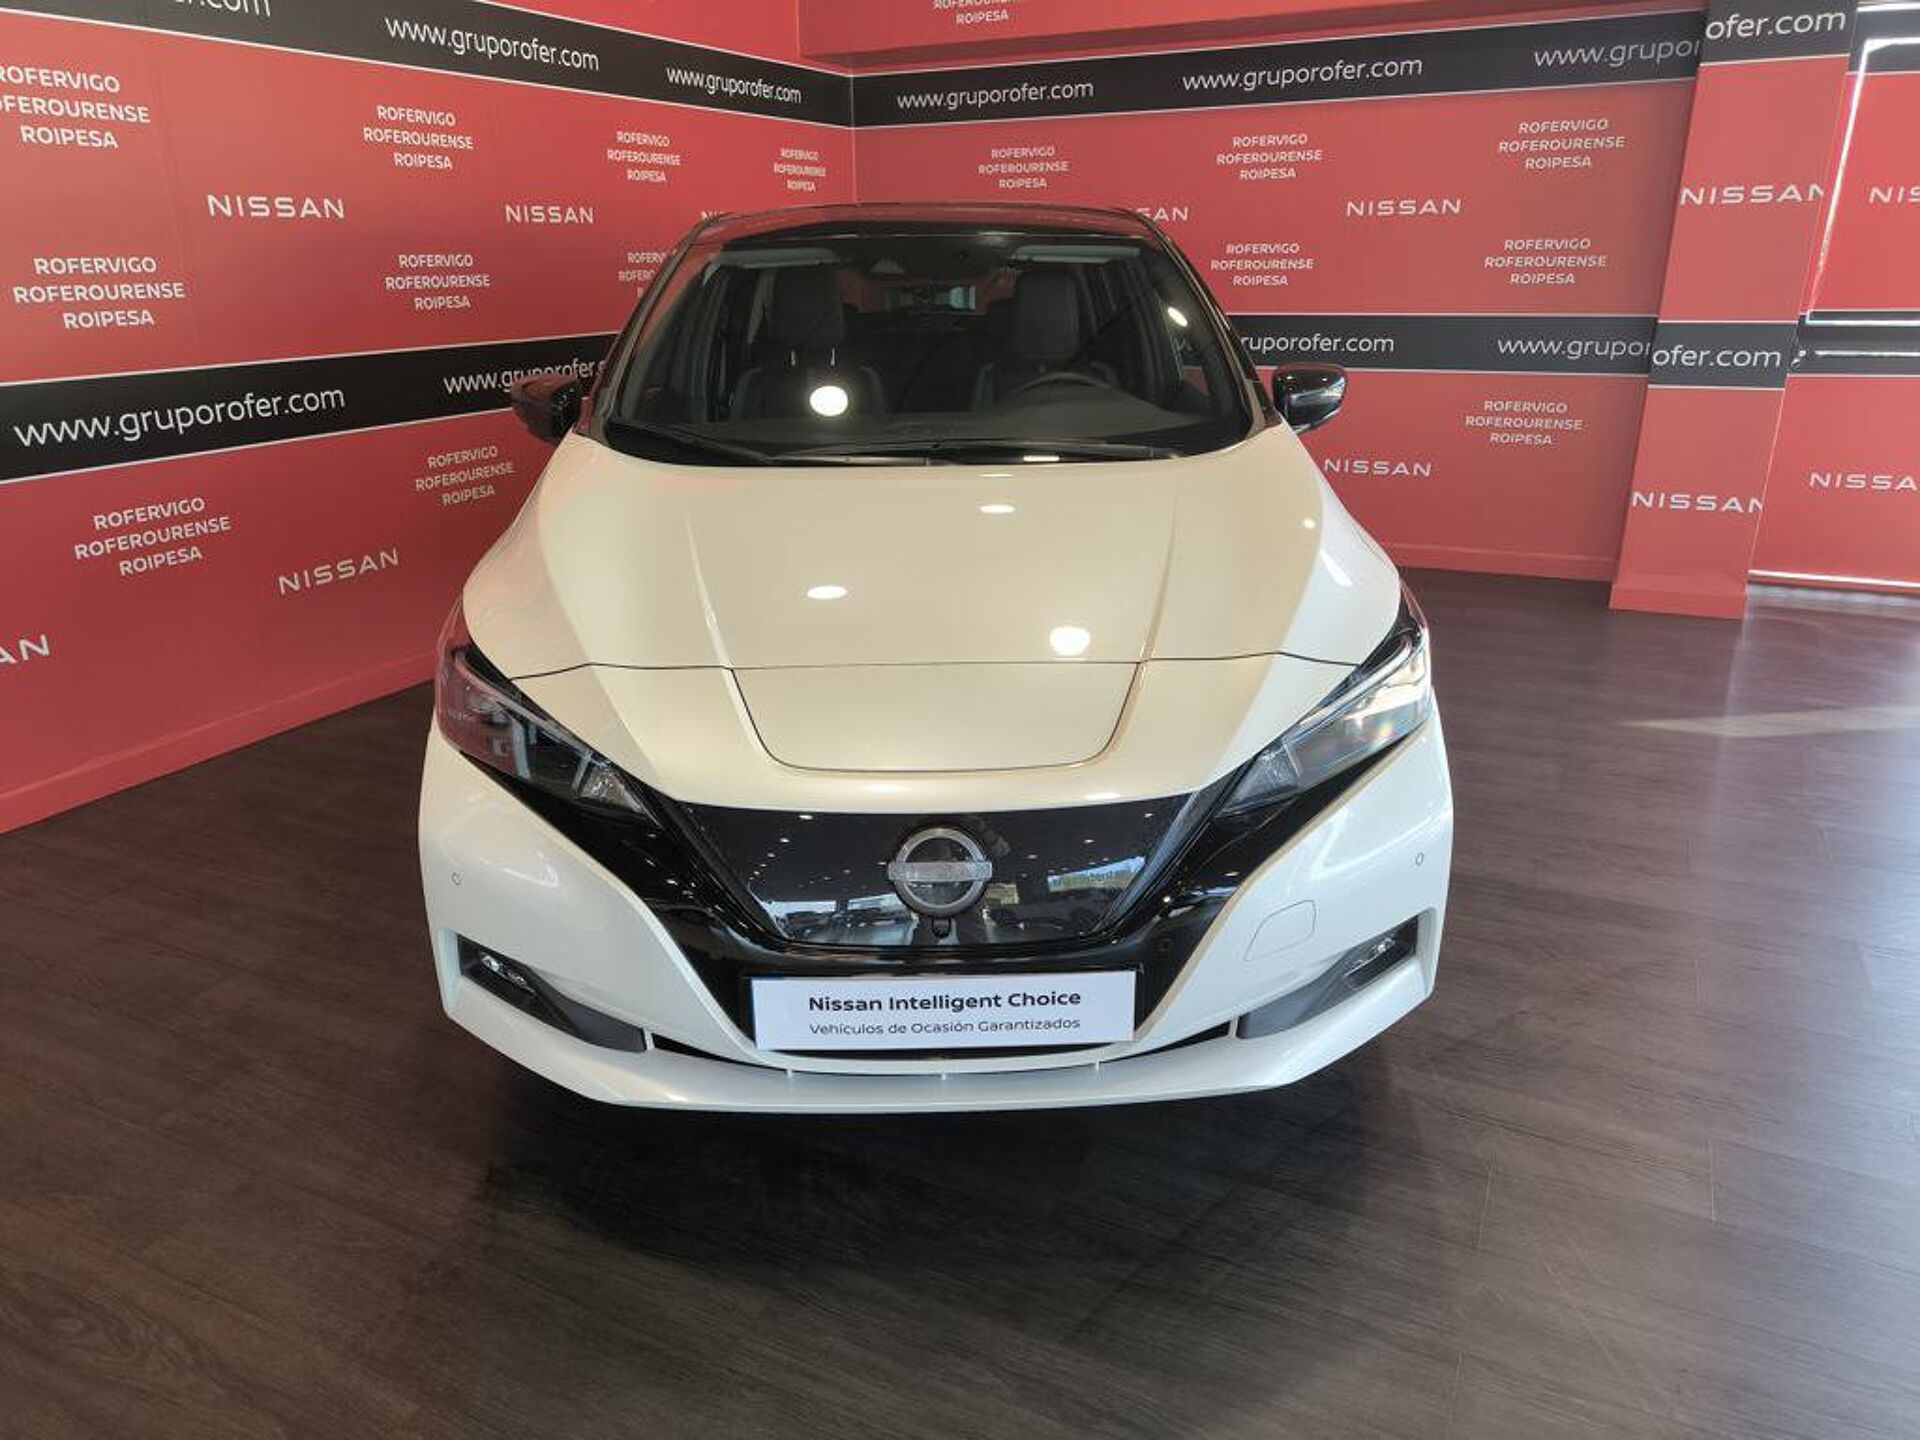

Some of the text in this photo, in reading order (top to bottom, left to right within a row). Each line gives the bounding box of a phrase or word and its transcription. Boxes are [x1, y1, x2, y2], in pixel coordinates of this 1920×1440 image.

[955, 9, 1009, 24] ROIPESA
[1705, 11, 1846, 40] ofer.com
[383, 15, 601, 72] www.gruporofer.com
[665, 65, 803, 105] www.gruporofer.com
[1182, 59, 1423, 92] www.gruporofer.com
[897, 82, 1094, 111] www.gruporofer.com
[375, 104, 457, 128] ROFERVIGO
[1518, 118, 1609, 134] ROFERVIGO
[20, 125, 119, 149] ROIPESA
[362, 126, 475, 151] ROFEROURENSE
[615, 130, 671, 149] ROFERVIGO
[1232, 133, 1308, 148] ROFERVIGO
[1499, 136, 1625, 153] ROFEROURENSE
[393, 151, 453, 170] ROIPESA
[606, 148, 682, 167] ROFEROURENSE
[991, 146, 1055, 159] ROFERVIGO
[1215, 149, 1324, 165] ROFEROURENSE
[978, 160, 1069, 175] ROFEROURENSE
[1525, 155, 1592, 170] ROIPESA
[626, 168, 668, 184] ROIPESA
[998, 177, 1047, 189] ROIPESA
[1239, 167, 1297, 180] ROIPESA
[1681, 184, 1824, 204] NISSAN
[207, 194, 345, 219] NISSAN
[505, 204, 594, 224] NISSAN
[1346, 198, 1461, 217] NISSAN
[1226, 242, 1300, 254] ROFERVIGO
[1503, 238, 1591, 251] ROFERVIGO
[33, 256, 157, 275] ROFERVIGO
[398, 254, 474, 269] ROFERVIGO
[1210, 258, 1314, 271] ROFEROURENSE
[1484, 255, 1607, 268] ROFEROURENSE
[385, 274, 490, 290] ROFEROURENSE
[1233, 275, 1289, 286] ROIPESA
[1510, 272, 1576, 285] ROIPESA
[12, 282, 185, 303] ROFEROURENSE
[414, 295, 471, 310] ROIPESA
[62, 309, 155, 329] ROIPESA
[1652, 344, 1782, 367] ofer.com
[1484, 400, 1568, 414] ROFERVIGO
[12, 385, 347, 449] www.gruporofer.com
[1465, 415, 1583, 430] ROFEROURENSE
[1490, 432, 1553, 445] ROIPESA
[425, 444, 500, 471] ROFERVIGO
[414, 459, 516, 492] ROFEROURENSE
[1322, 457, 1433, 478] NISSAN
[440, 481, 497, 507] ROIPESA
[1633, 492, 1762, 512] NISSAN
[92, 496, 207, 531] ROFERVIGO
[73, 515, 232, 562] ROFEROURENSE
[118, 544, 204, 577] ROIPESA
[278, 547, 399, 595] NISSAN
[808, 990, 1082, 1013] Nissan Intelligent Choice
[809, 1017, 1081, 1035] Vehículos de Ocasión Garantizados
